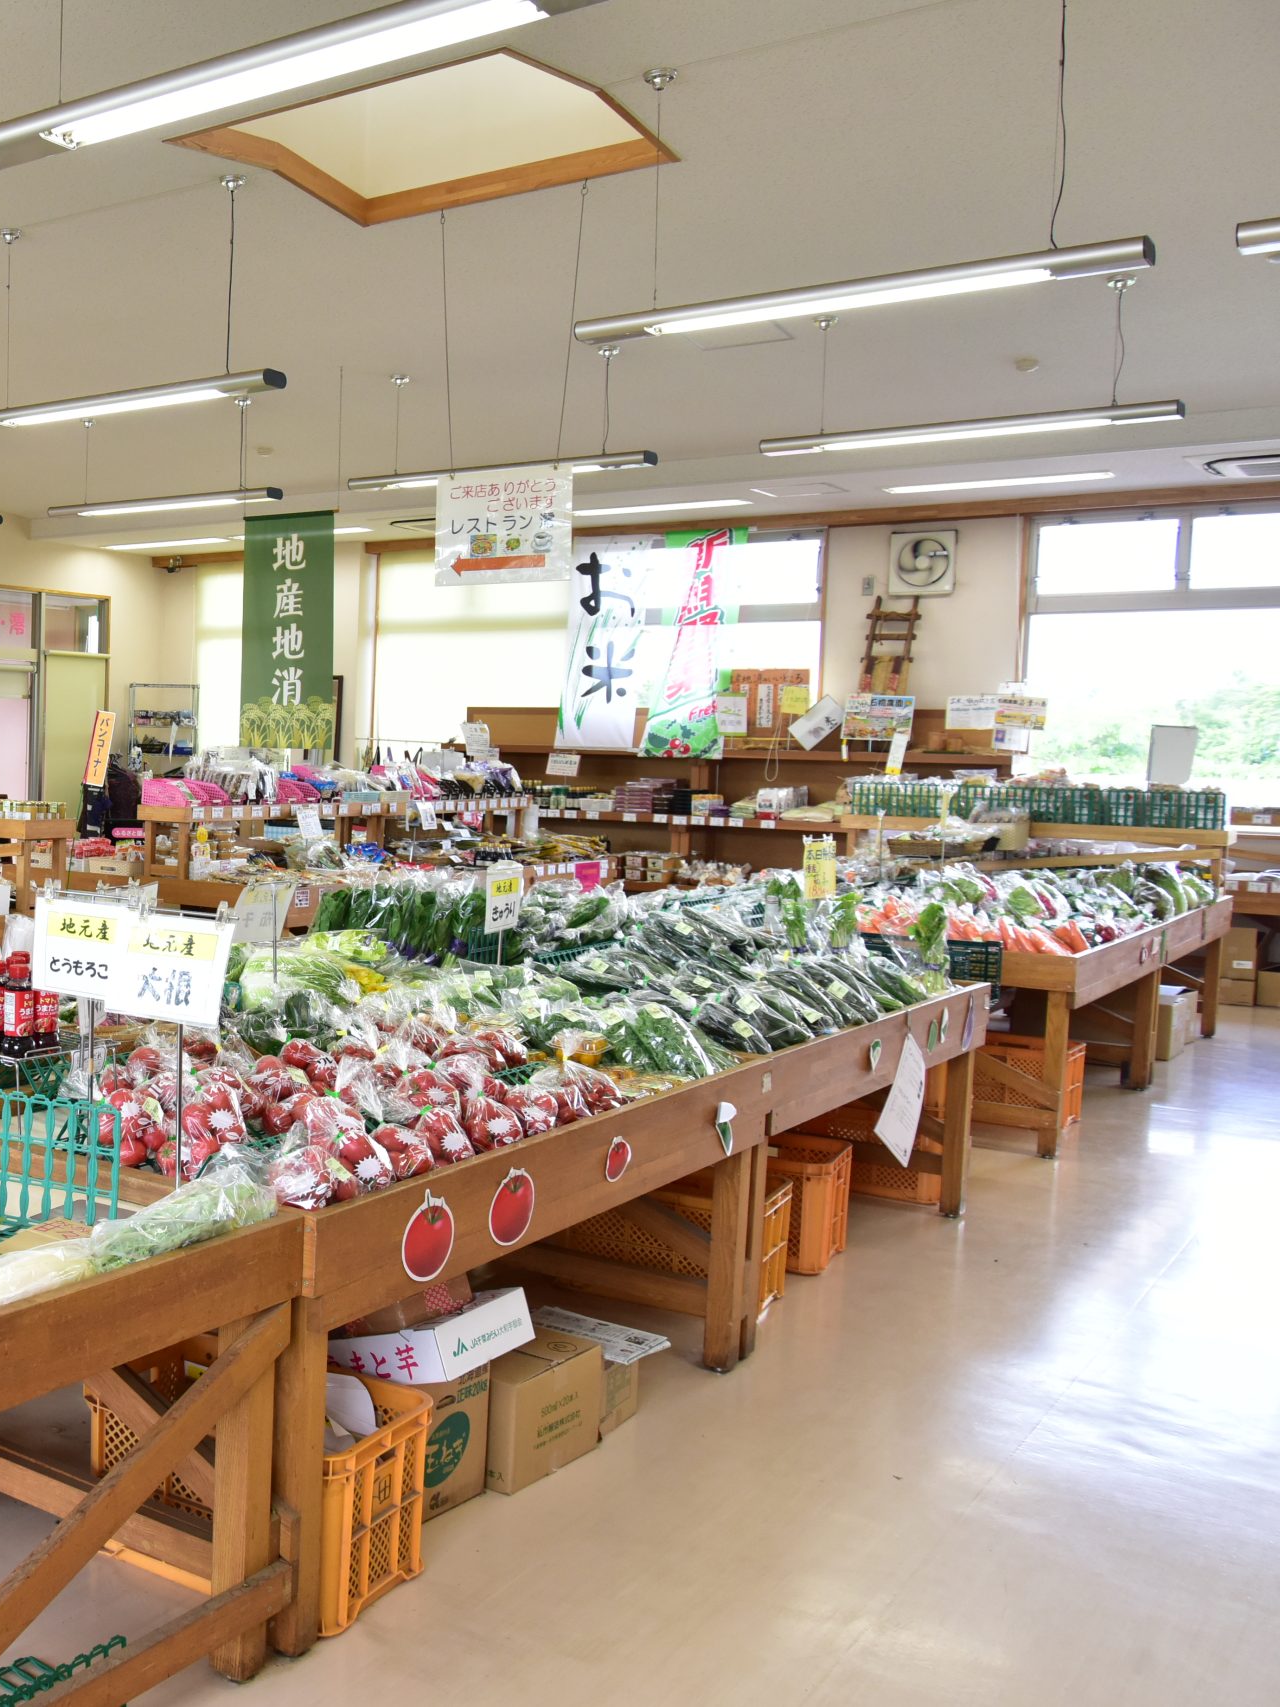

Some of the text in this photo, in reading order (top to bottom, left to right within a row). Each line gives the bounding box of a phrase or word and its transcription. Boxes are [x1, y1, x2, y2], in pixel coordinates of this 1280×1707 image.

[450, 478, 556, 500] ご来店ありがとう
[487, 496, 556, 512] ございます
[451, 515, 533, 535] レストラン
[272, 533, 306, 706] 地産地消
[575, 552, 636, 704] お米
[496, 880, 512, 893] 地元産
[492, 901, 516, 921] きゅうり
[60, 917, 110, 941] 地元産
